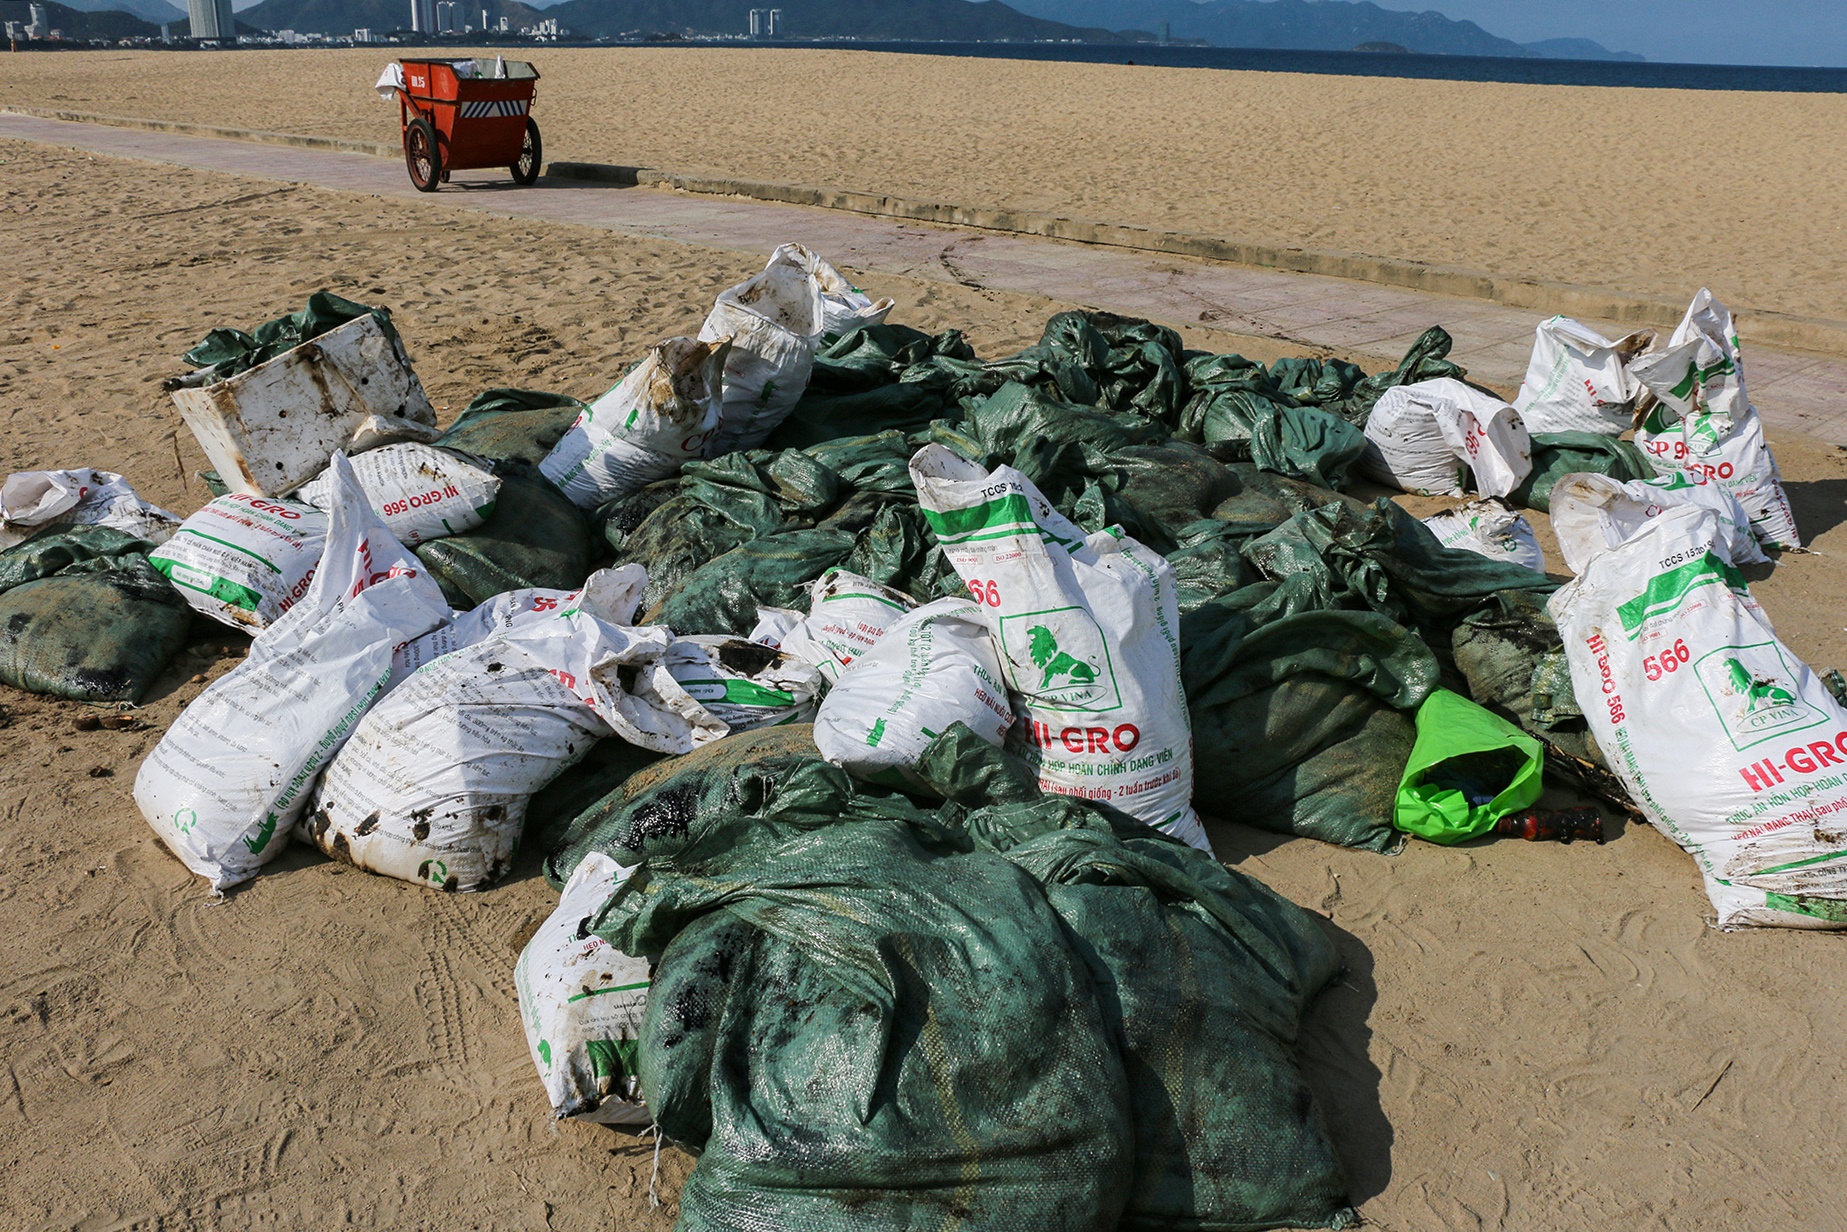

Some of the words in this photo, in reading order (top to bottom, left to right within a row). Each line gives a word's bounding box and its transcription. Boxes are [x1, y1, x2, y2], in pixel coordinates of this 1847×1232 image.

[409, 485, 459, 509] HI-GRO
[981, 482, 1008, 499] TCCS
[383, 500, 408, 517] 566
[1658, 552, 1684, 569] TCCS
[966, 578, 1002, 607] 66
[1643, 638, 1690, 681] 566
[1063, 690, 1092, 703] VINA
[1606, 694, 1626, 724] 566
[1751, 714, 1766, 728] CP
[1769, 708, 1799, 724] VINA
[1024, 717, 1140, 754] HI-GRO
[1049, 759, 1066, 773] HỢP
[1068, 760, 1094, 776] HOÀN
[1097, 757, 1127, 777] CHỈNH
[1130, 754, 1154, 772] DẠNG
[1156, 747, 1173, 765] VIÊN
[1089, 784, 1112, 801] giống
[1119, 787, 1124, 797] 2
[1126, 781, 1143, 796] tuần
[1145, 778, 1162, 793] trước
[1162, 772, 1172, 786] khi
[1753, 800, 1767, 817] ĂN
[1769, 791, 1791, 810] HỖN
[1791, 784, 1811, 800] HỢP
[1813, 773, 1842, 792] HOÀN
[1648, 799, 1666, 818] phối
[1660, 812, 1681, 834] giống
